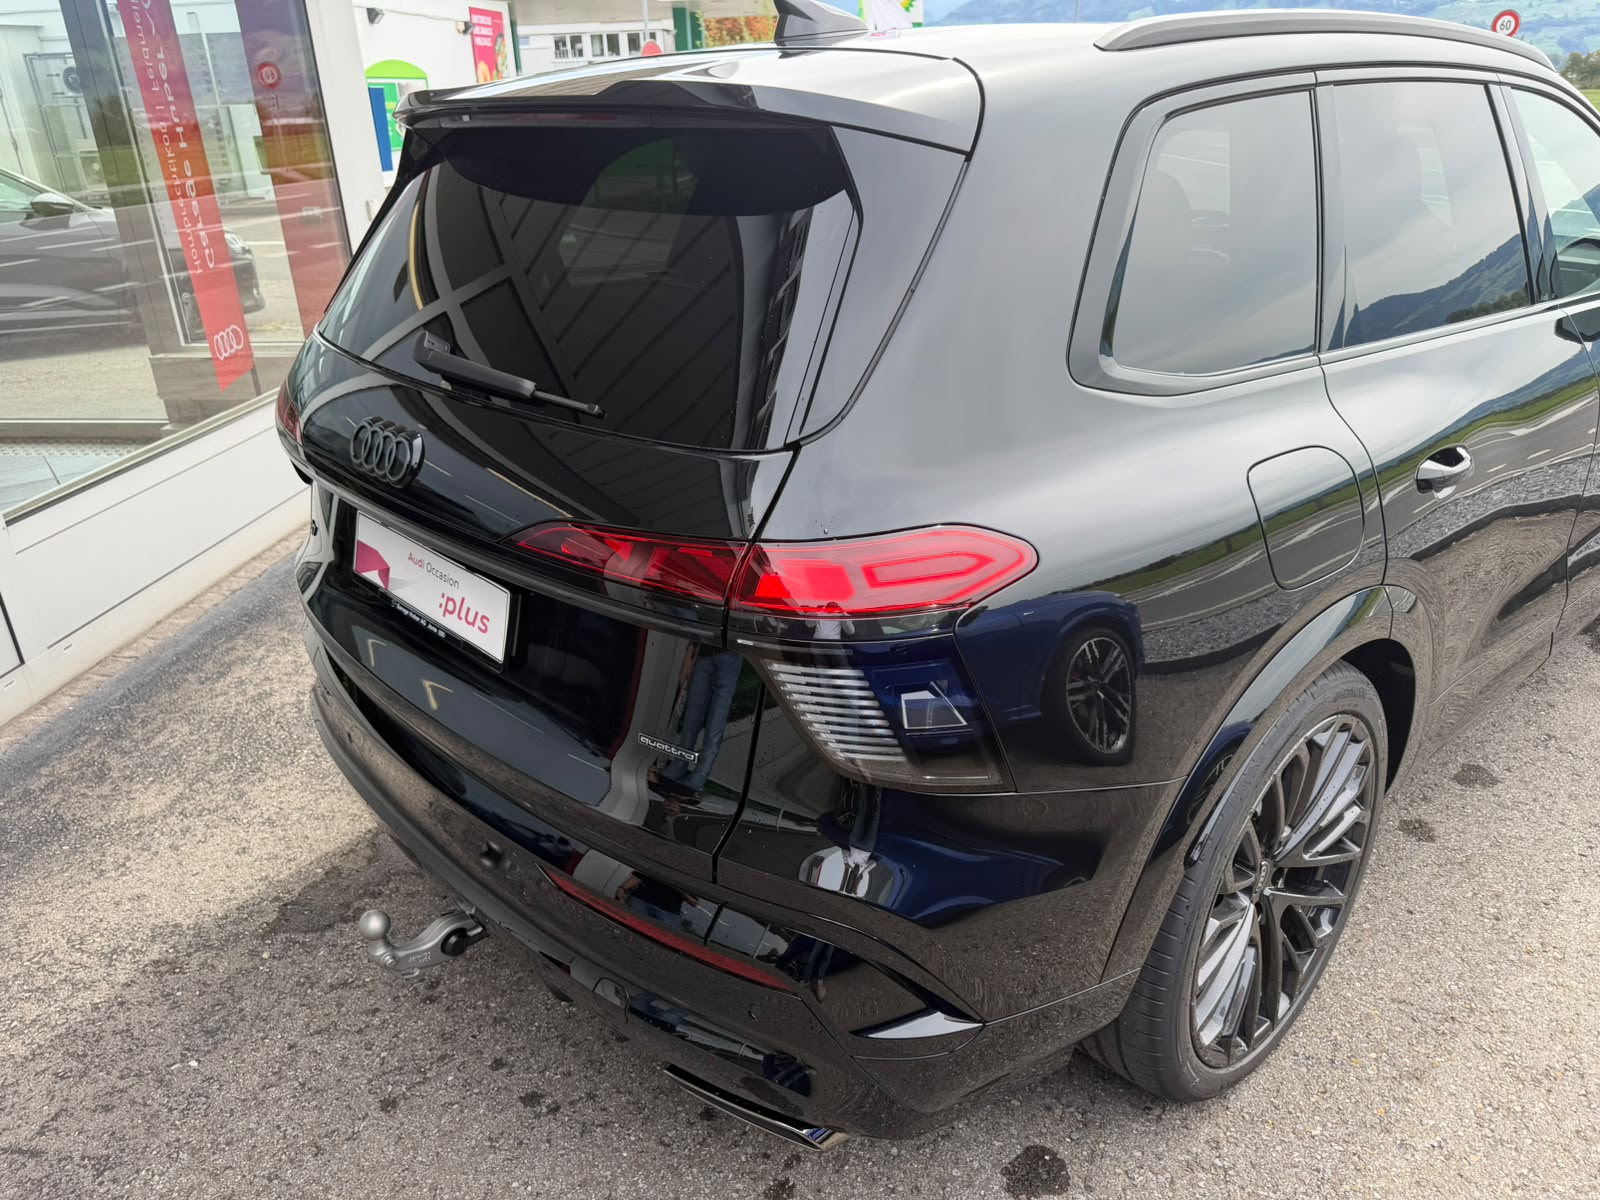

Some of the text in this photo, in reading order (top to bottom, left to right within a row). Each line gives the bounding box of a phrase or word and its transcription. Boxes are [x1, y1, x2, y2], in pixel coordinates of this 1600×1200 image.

[1500, 20, 1511, 30] 60
[407, 552, 460, 590] Audi Occasion
[640, 736, 695, 761] quattro
